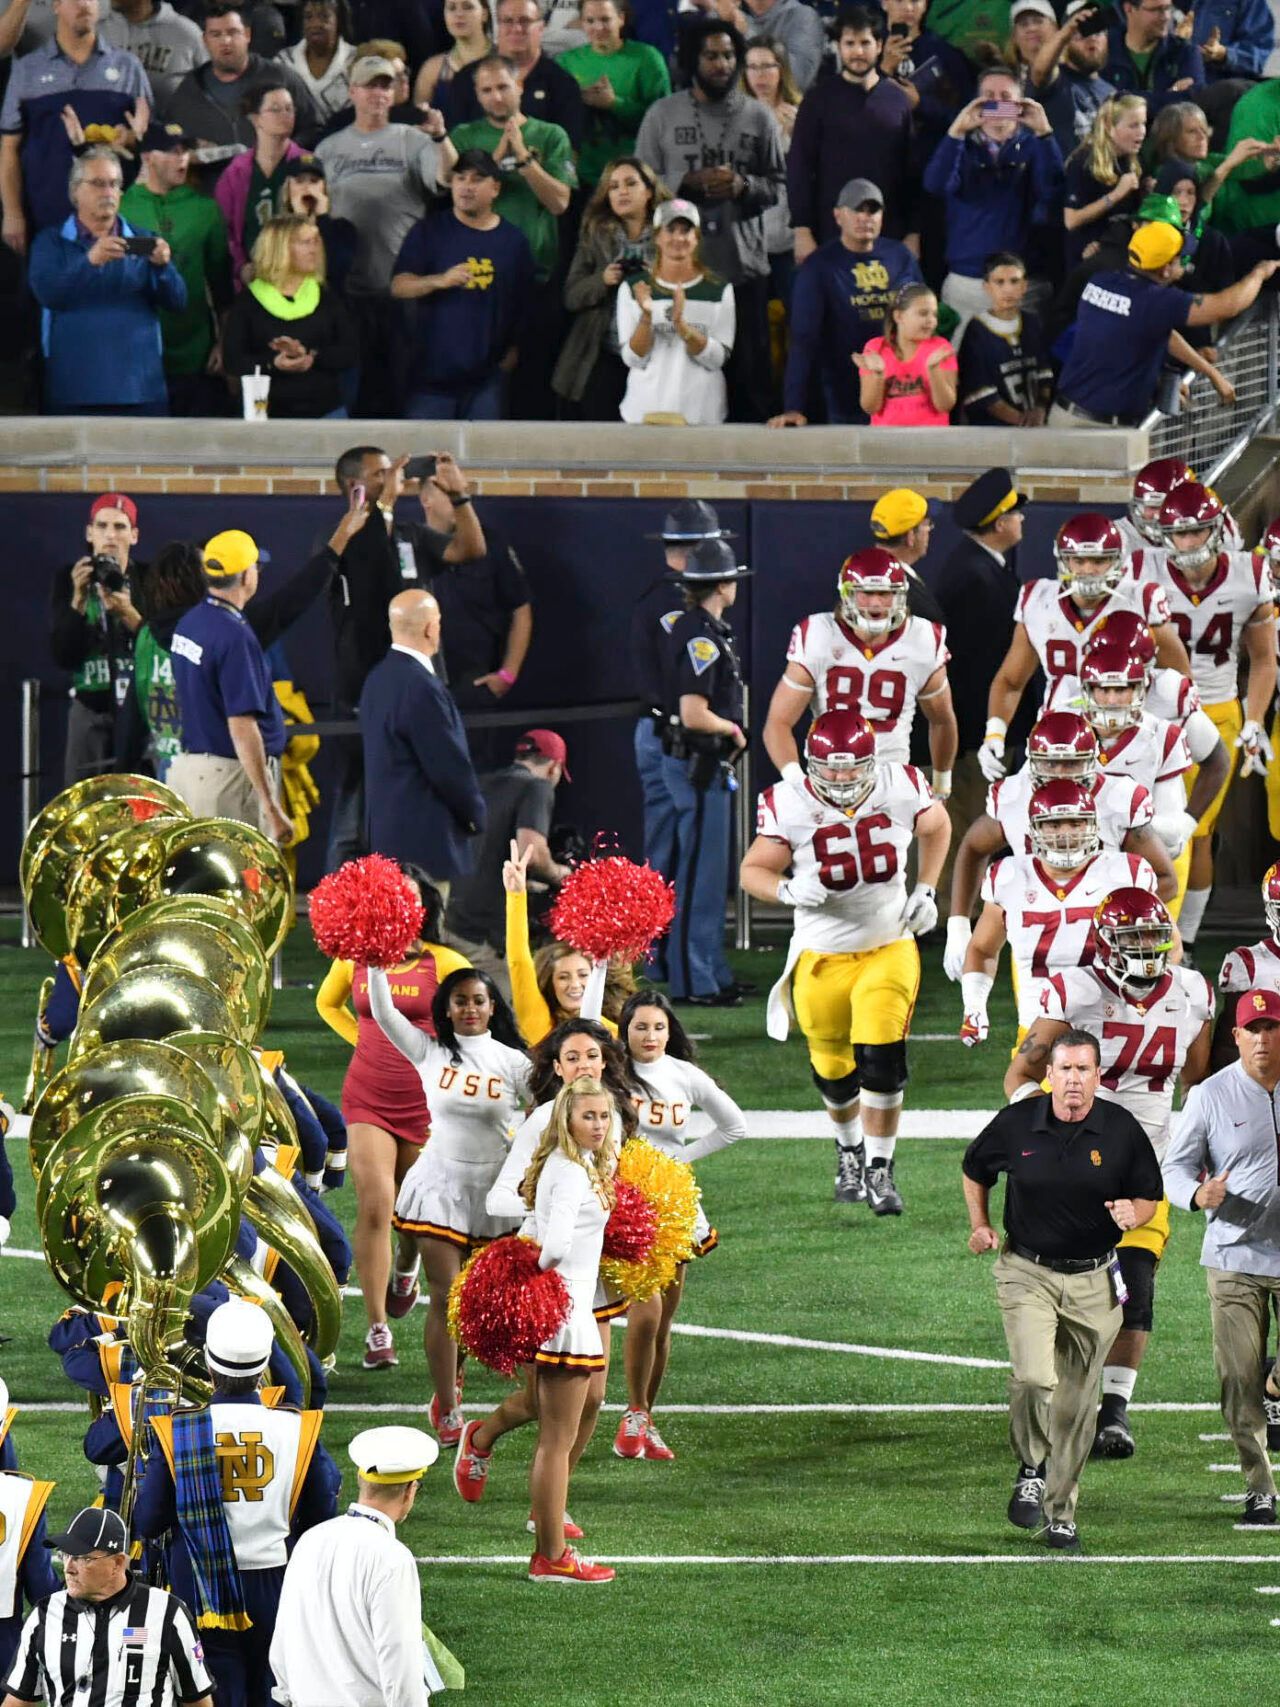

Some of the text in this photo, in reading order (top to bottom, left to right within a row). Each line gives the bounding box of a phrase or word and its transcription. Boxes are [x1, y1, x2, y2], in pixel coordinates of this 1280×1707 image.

[1081, 282, 1131, 316] USHER
[826, 665, 907, 733] 89
[812, 813, 898, 891] 66
[1022, 906, 1098, 978] 77
[360, 982, 418, 998] TANS
[439, 1067, 503, 1100] USC
[1103, 1021, 1177, 1092] 74
[213, 1431, 274, 1503] ND
[128, 1665, 139, 1683] L
